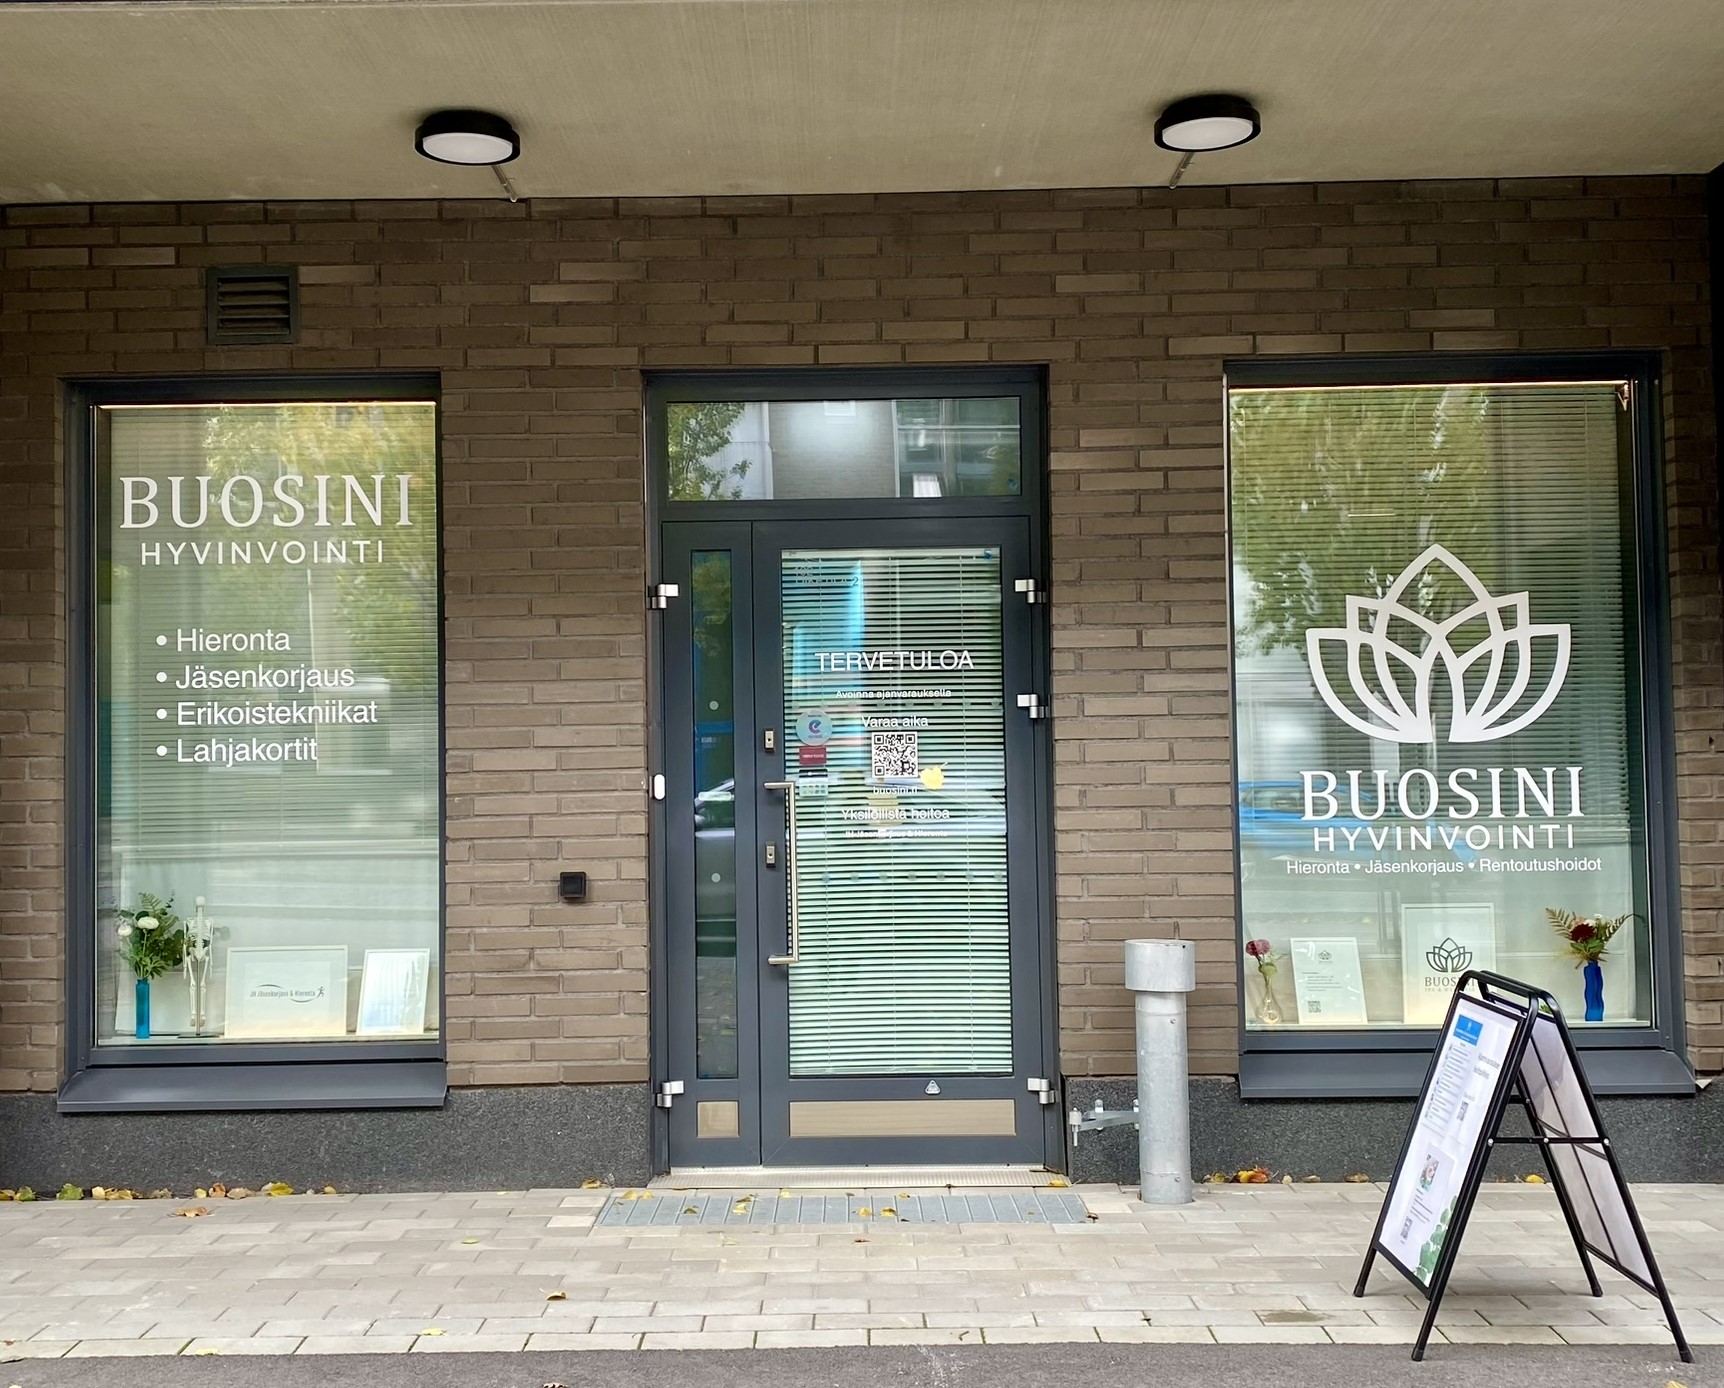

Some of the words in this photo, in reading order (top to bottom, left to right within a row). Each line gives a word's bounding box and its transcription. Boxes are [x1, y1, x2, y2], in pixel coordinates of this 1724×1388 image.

[119, 474, 413, 529] BUOSINI
[140, 540, 384, 566] HYVINVOINTI
[176, 628, 291, 652] Hieronta
[814, 650, 975, 672] TERVETULOA
[175, 664, 355, 694] Jäsenkorjaus
[835, 690, 874, 699] Avoinna
[876, 688, 952, 700] ajanvarauksella
[176, 700, 378, 726] Erikoistekniikat
[861, 716, 899, 728] Varaa
[902, 715, 930, 727] aika
[176, 737, 318, 768] Lahjakortit
[1299, 766, 1585, 821] BUOSINI
[911, 808, 950, 820] hoitoa
[1313, 823, 1575, 852] HYVINVOINTI
[1286, 860, 1350, 875] Hieronta
[1364, 859, 1464, 876] Jäsenkorjaus
[1479, 857, 1602, 873] Rentoutushoidot
[1425, 976, 1475, 987] BUOSI
